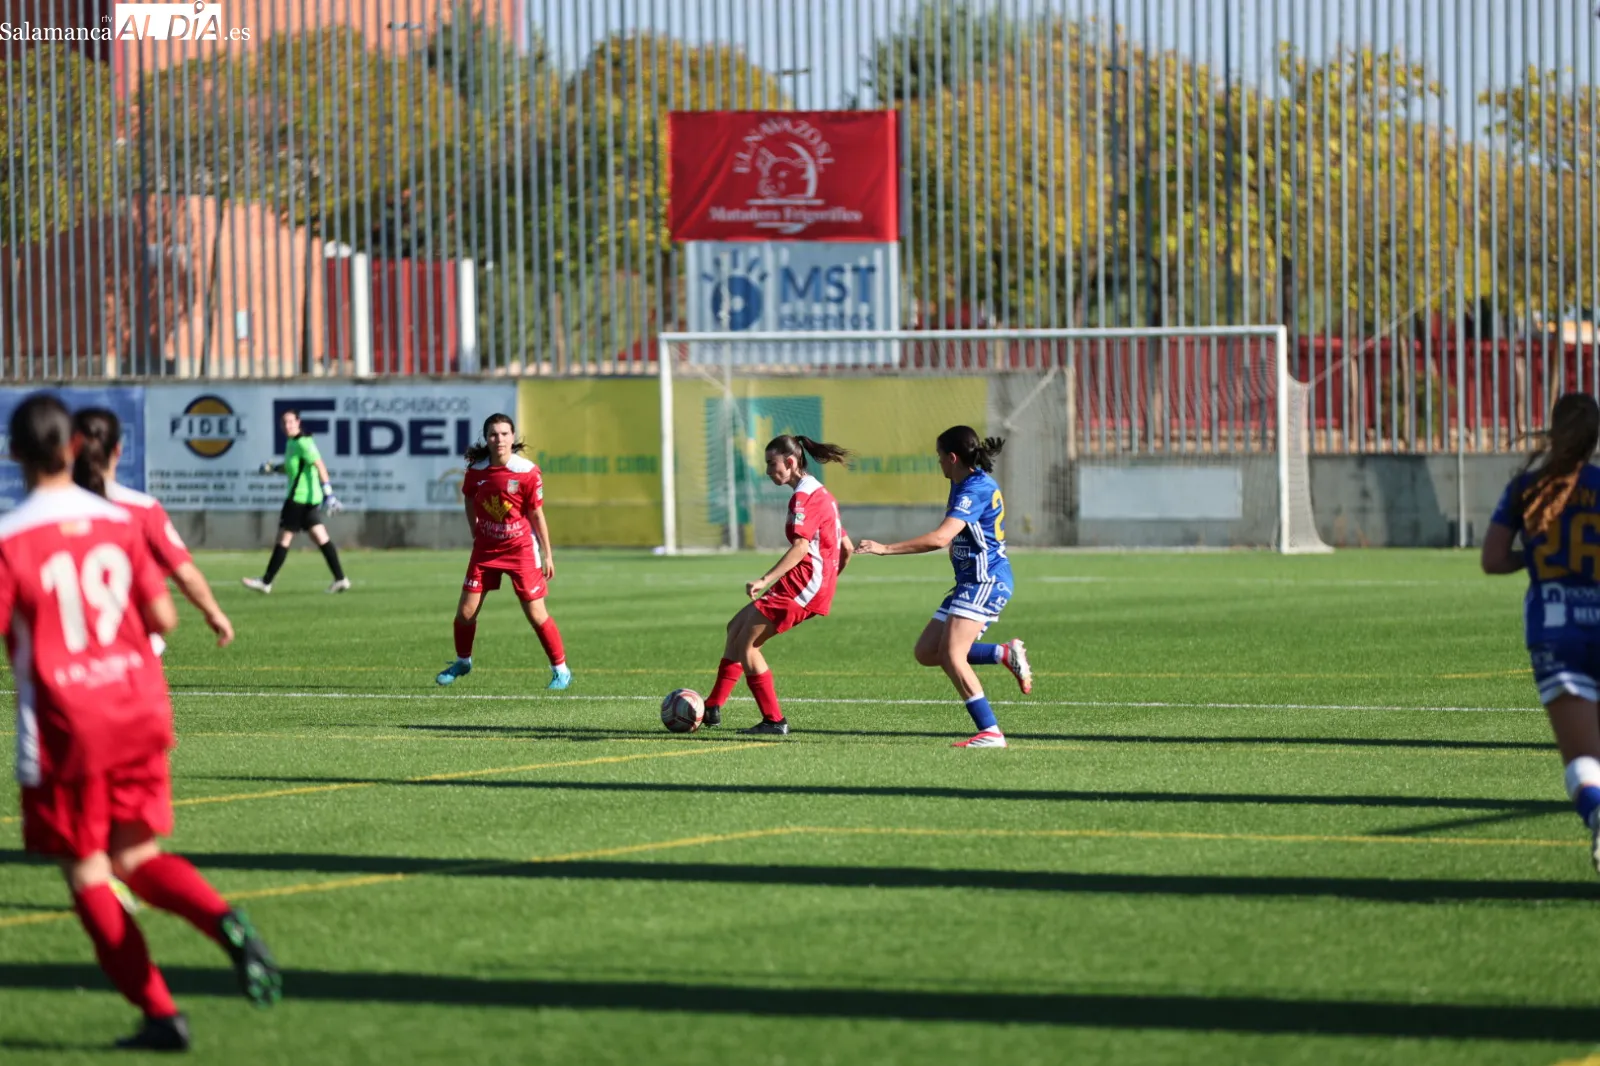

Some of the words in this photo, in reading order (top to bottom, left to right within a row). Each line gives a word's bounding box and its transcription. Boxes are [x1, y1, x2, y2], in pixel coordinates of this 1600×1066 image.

[779, 265, 876, 304] MST
[170, 417, 247, 437] FIDEL
[39, 541, 132, 653] 19
